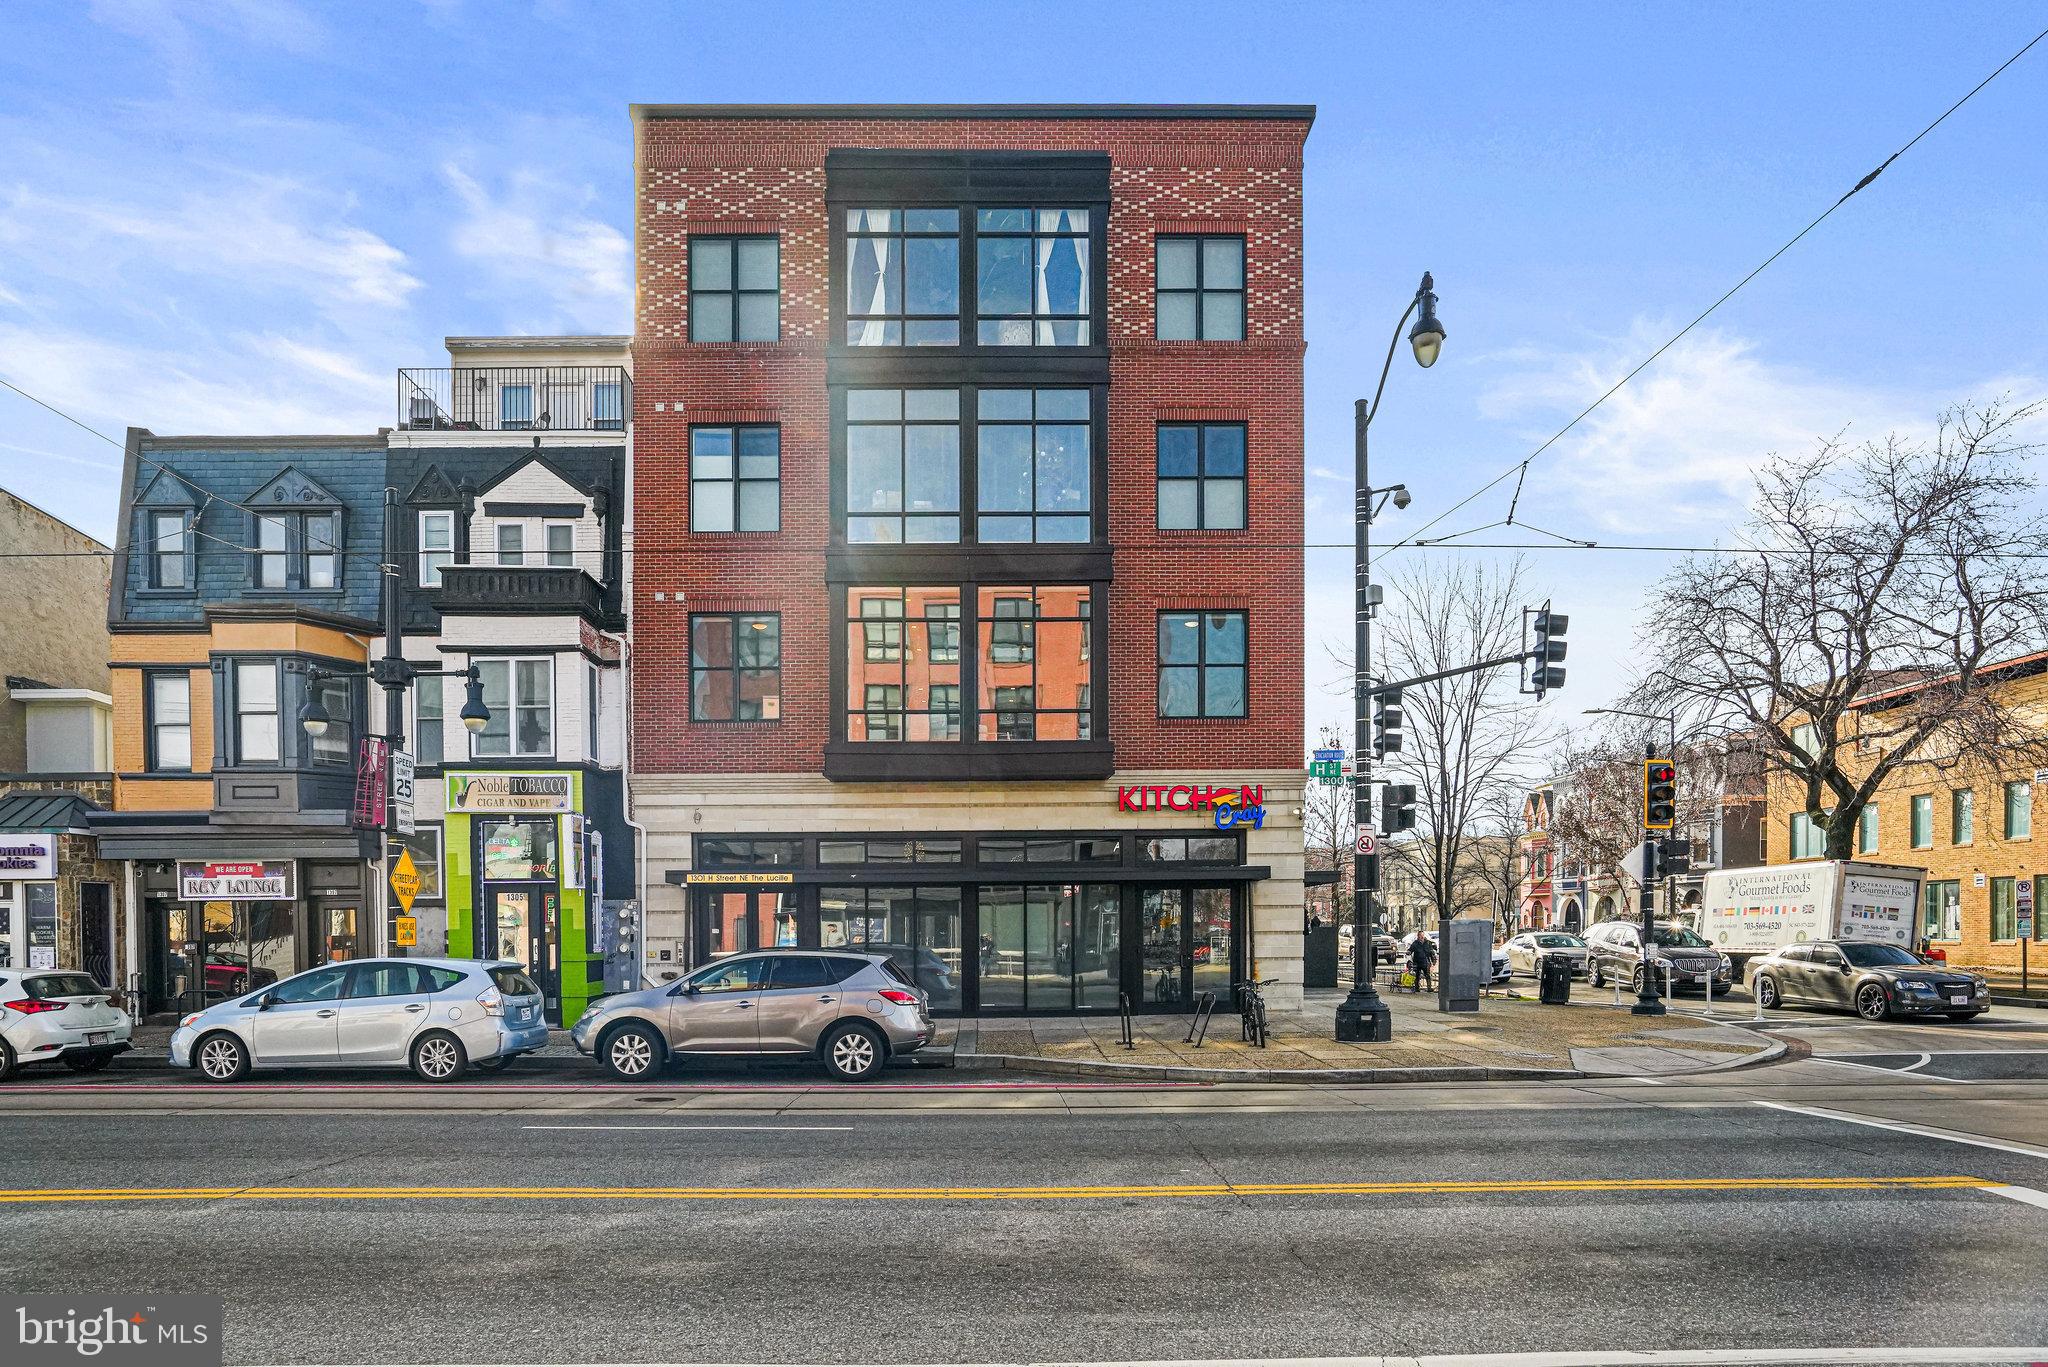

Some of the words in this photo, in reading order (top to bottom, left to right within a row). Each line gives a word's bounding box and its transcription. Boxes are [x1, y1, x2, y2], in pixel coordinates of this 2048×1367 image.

[395, 756, 413, 768] SPEED
[396, 768, 411, 777] LIMIT
[1315, 764, 1325, 775] H
[477, 778, 509, 793] Noble
[511, 778, 567, 793] TOBACCO
[1320, 776, 1344, 785] 1300
[396, 779, 412, 799] 25
[477, 799, 505, 808] CIGAR
[507, 799, 526, 808] AND
[529, 799, 551, 808] VAPE
[1215, 802, 1266, 830] Cray
[394, 873, 419, 884] STREETCAR
[690, 874, 705, 882] 1301
[708, 874, 713, 882] H
[715, 874, 737, 882] Street
[740, 874, 748, 882] NE
[751, 874, 764, 882] The
[766, 874, 789, 882] Lucille
[1739, 872, 1812, 884] INTERNATIONAL
[226, 879, 282, 895] LOUNGE
[398, 886, 415, 897] TRACKS
[1738, 883, 1780, 897] Gourmet
[1781, 880, 1811, 894] Foods
[1859, 882, 1911, 891] INTERNATIONAL
[1859, 885, 1890, 895] Gourmet
[1891, 888, 1912, 897] Foods
[506, 893, 524, 901] 1305
[1743, 921, 1782, 930] 703-569-4520
